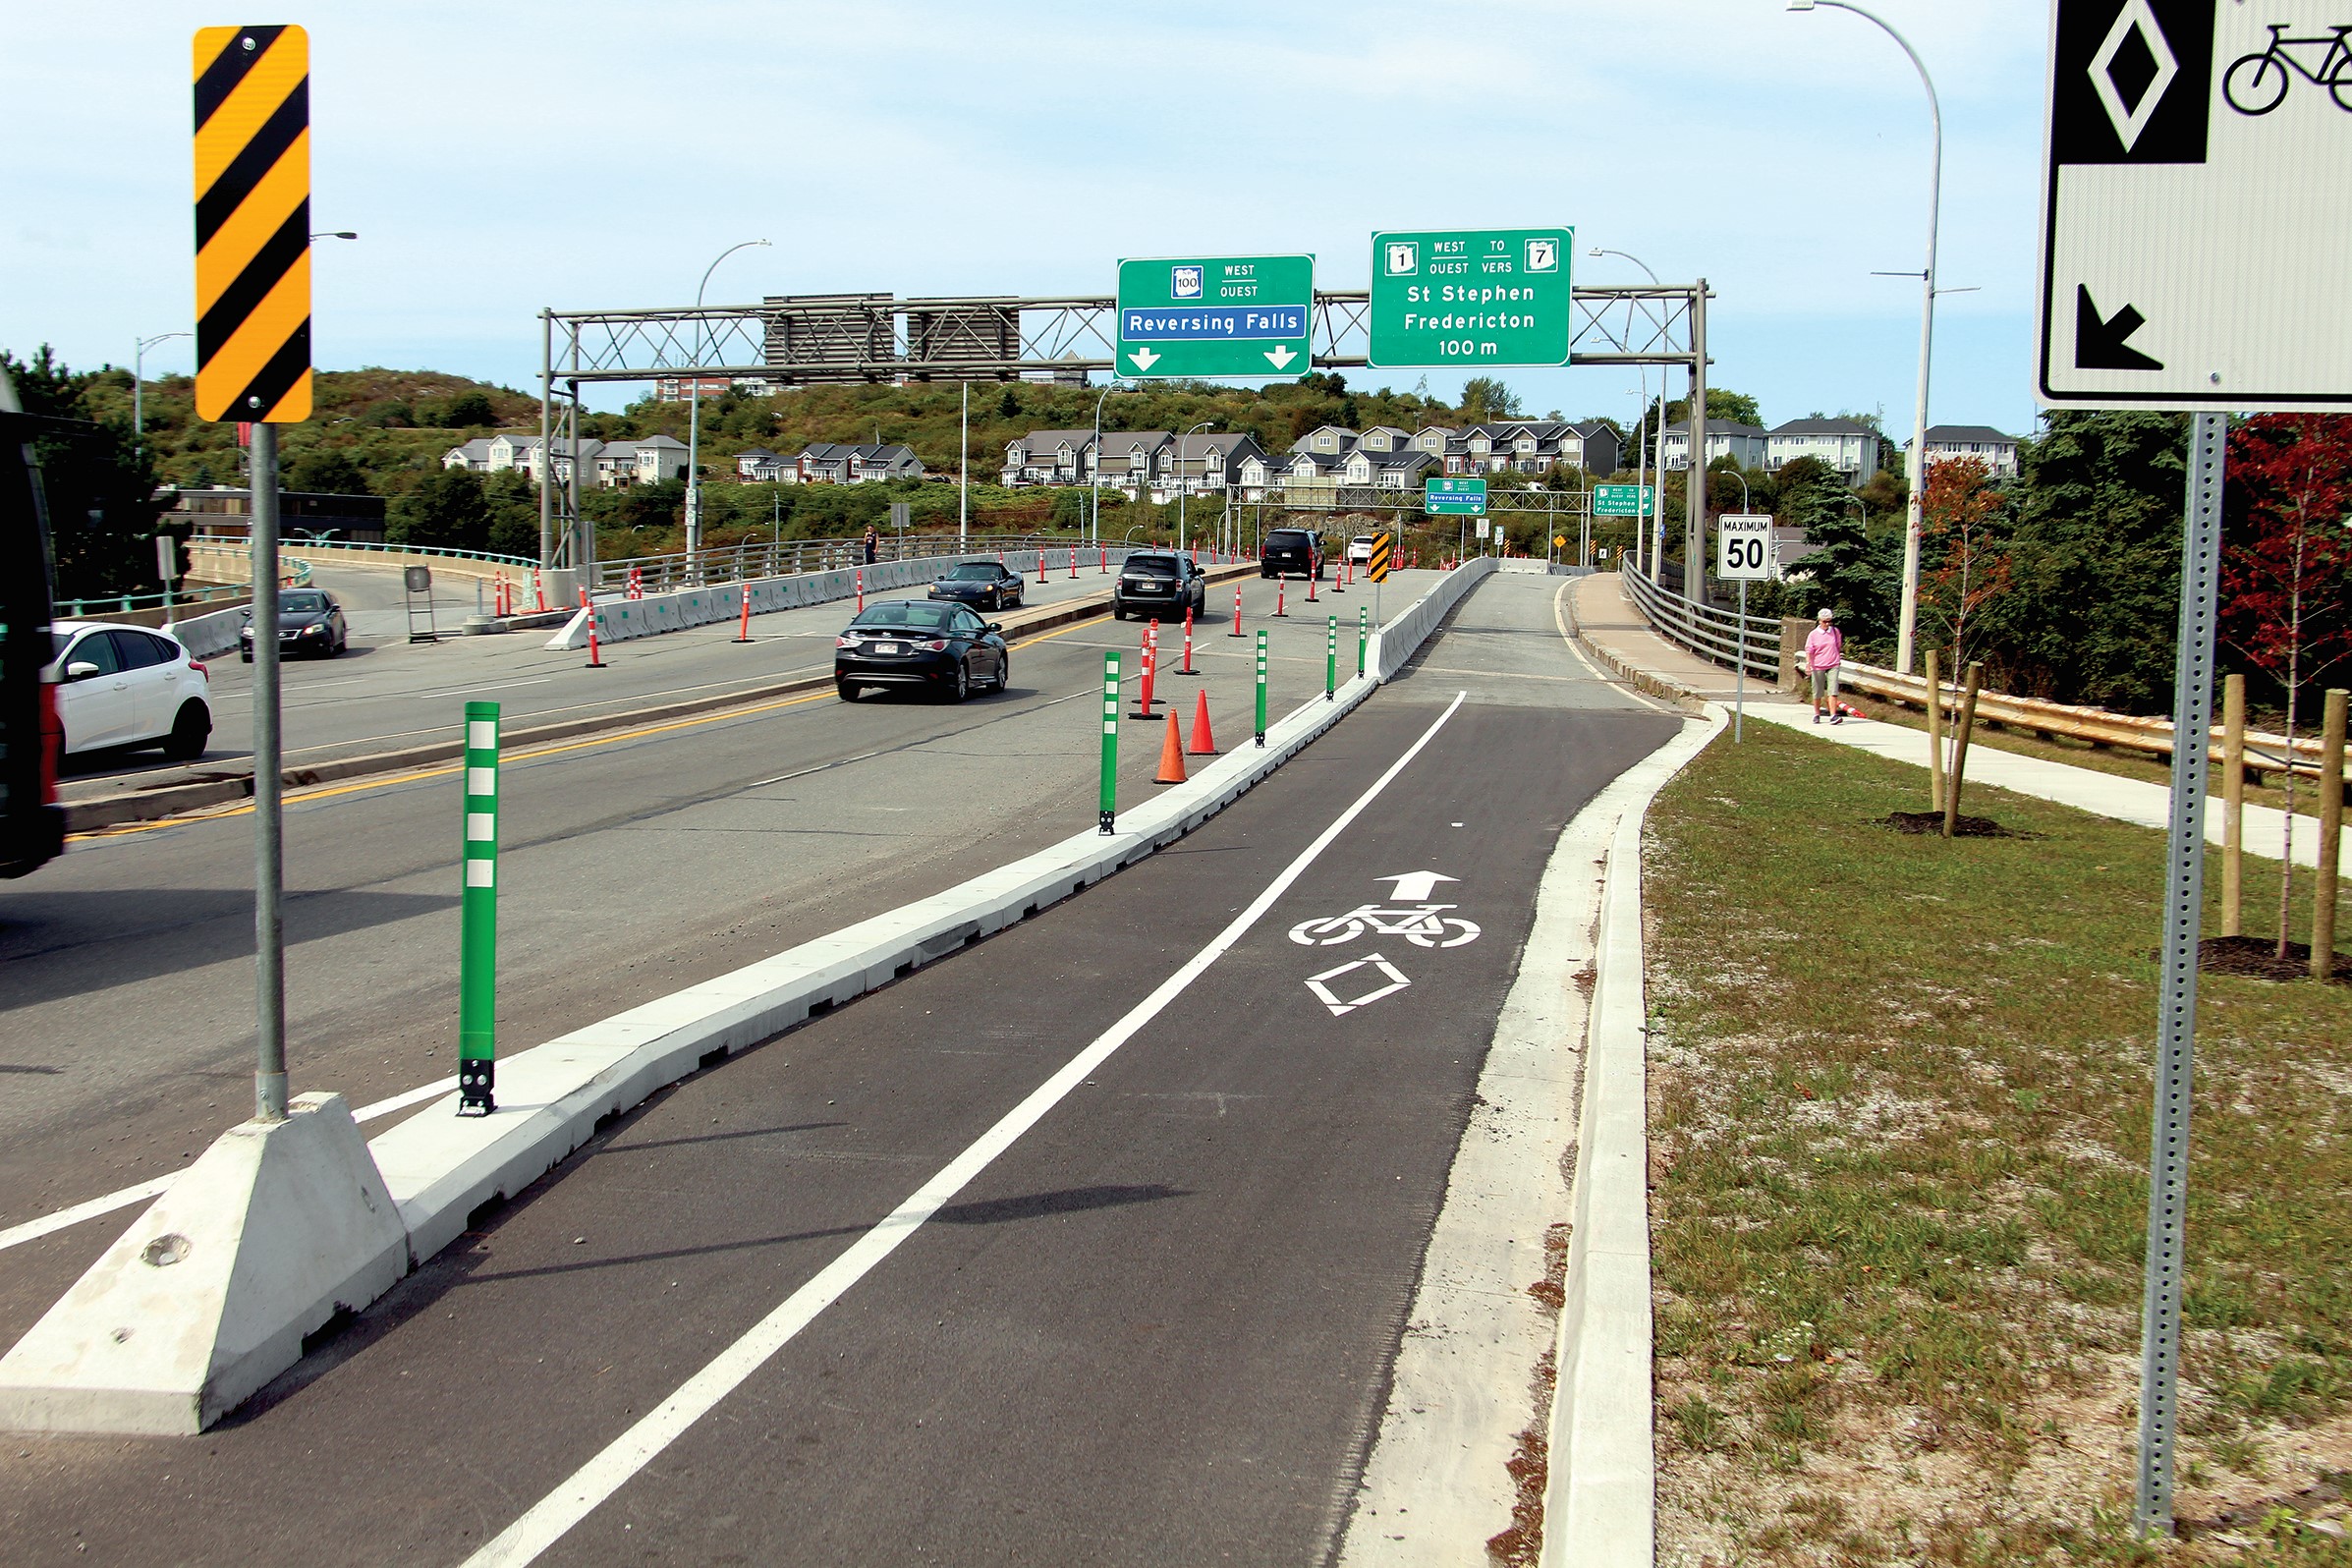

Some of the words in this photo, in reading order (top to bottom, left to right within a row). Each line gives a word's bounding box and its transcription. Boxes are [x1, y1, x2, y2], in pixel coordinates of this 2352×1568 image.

[1433, 241, 1465, 252] WEST
[1489, 240, 1505, 251] TO
[1398, 252, 1405, 266] 1
[1536, 250, 1546, 263] 7
[1224, 265, 1255, 276] WEST
[1429, 262, 1469, 274] OUEST
[1482, 261, 1513, 273] VERS
[1178, 277, 1198, 288] 100
[1220, 286, 1258, 297] OUEST
[1407, 285, 1430, 302] St
[1441, 284, 1535, 305] Stephen
[1130, 314, 1234, 334] Reversing
[1246, 312, 1298, 329] Falls
[1405, 311, 1535, 329] Fredericton
[1439, 340, 1474, 356] 100
[1481, 342, 1497, 355] m
[1724, 522, 1767, 532] MAXIMUM
[1727, 538, 1763, 569] 50
